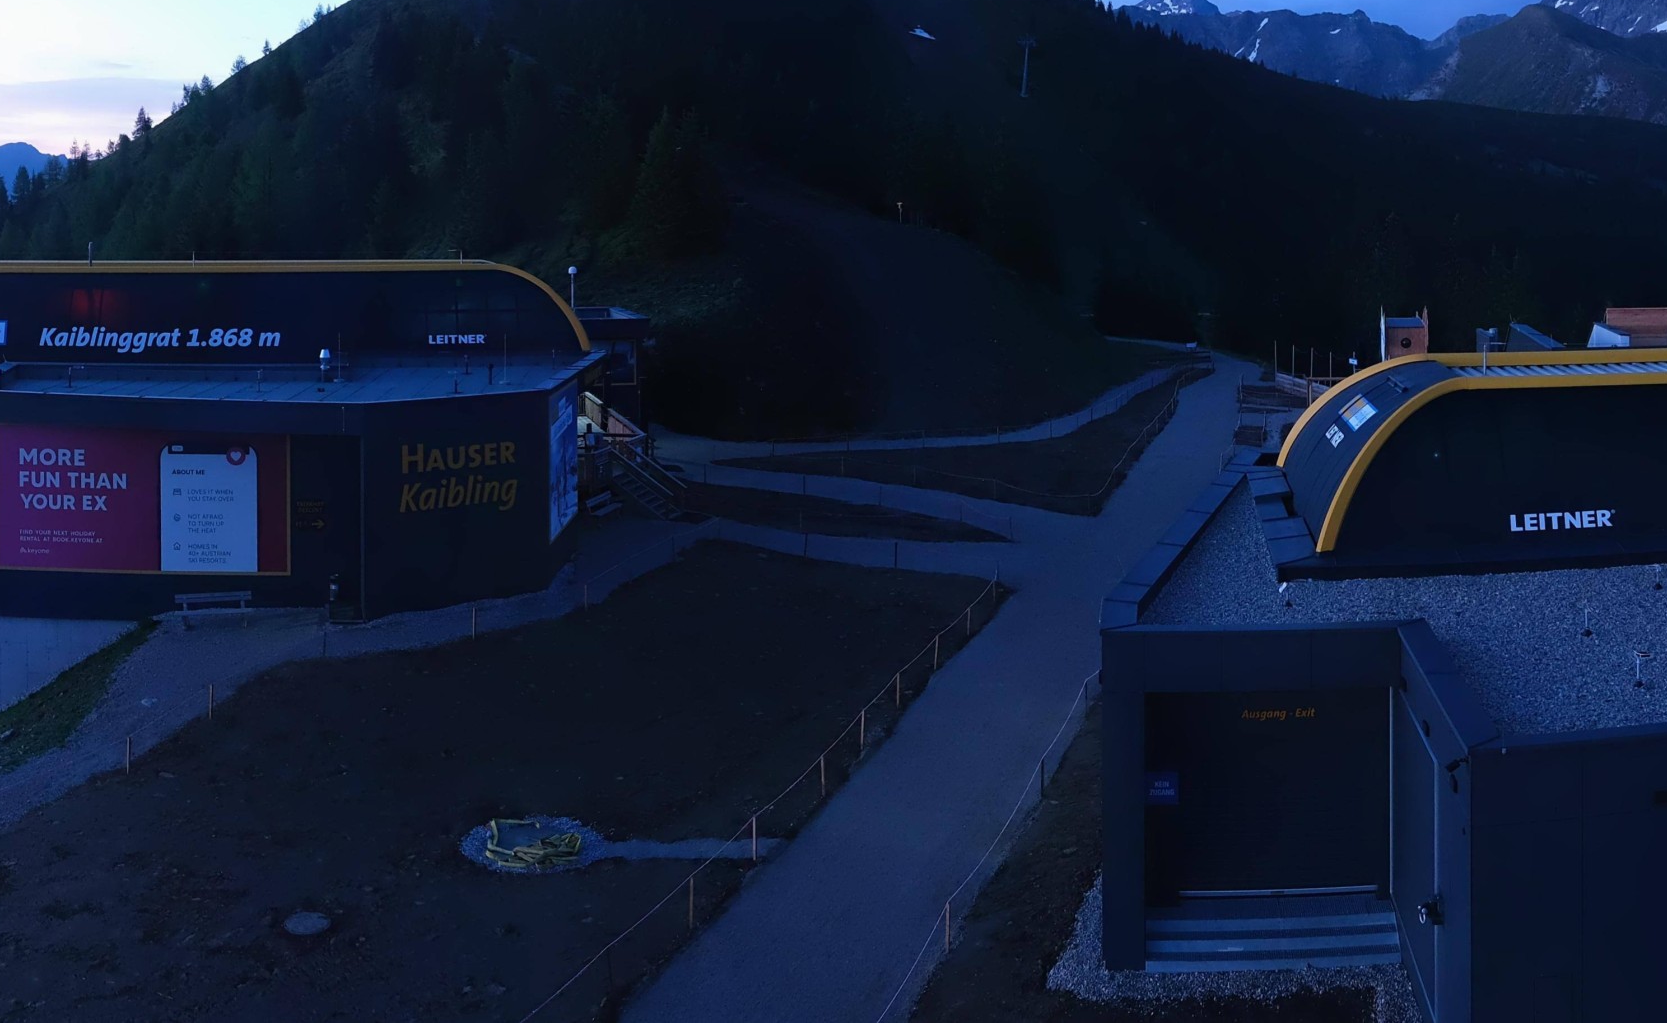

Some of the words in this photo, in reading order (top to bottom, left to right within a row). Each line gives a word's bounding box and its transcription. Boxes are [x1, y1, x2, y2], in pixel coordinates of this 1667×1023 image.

[39, 326, 181, 353] Kaiblinggrat
[186, 328, 252, 347] 1.868
[258, 331, 281, 347] m
[18, 448, 86, 466] MORE
[401, 441, 516, 474] HAUSER
[19, 471, 60, 488] FUN
[67, 472, 127, 490] THAN
[20, 494, 76, 510] YOUR
[82, 495, 108, 511] EX
[400, 474, 518, 513] Kaibling
[1241, 709, 1287, 721] Ausgang
[1296, 707, 1316, 717] Exit
